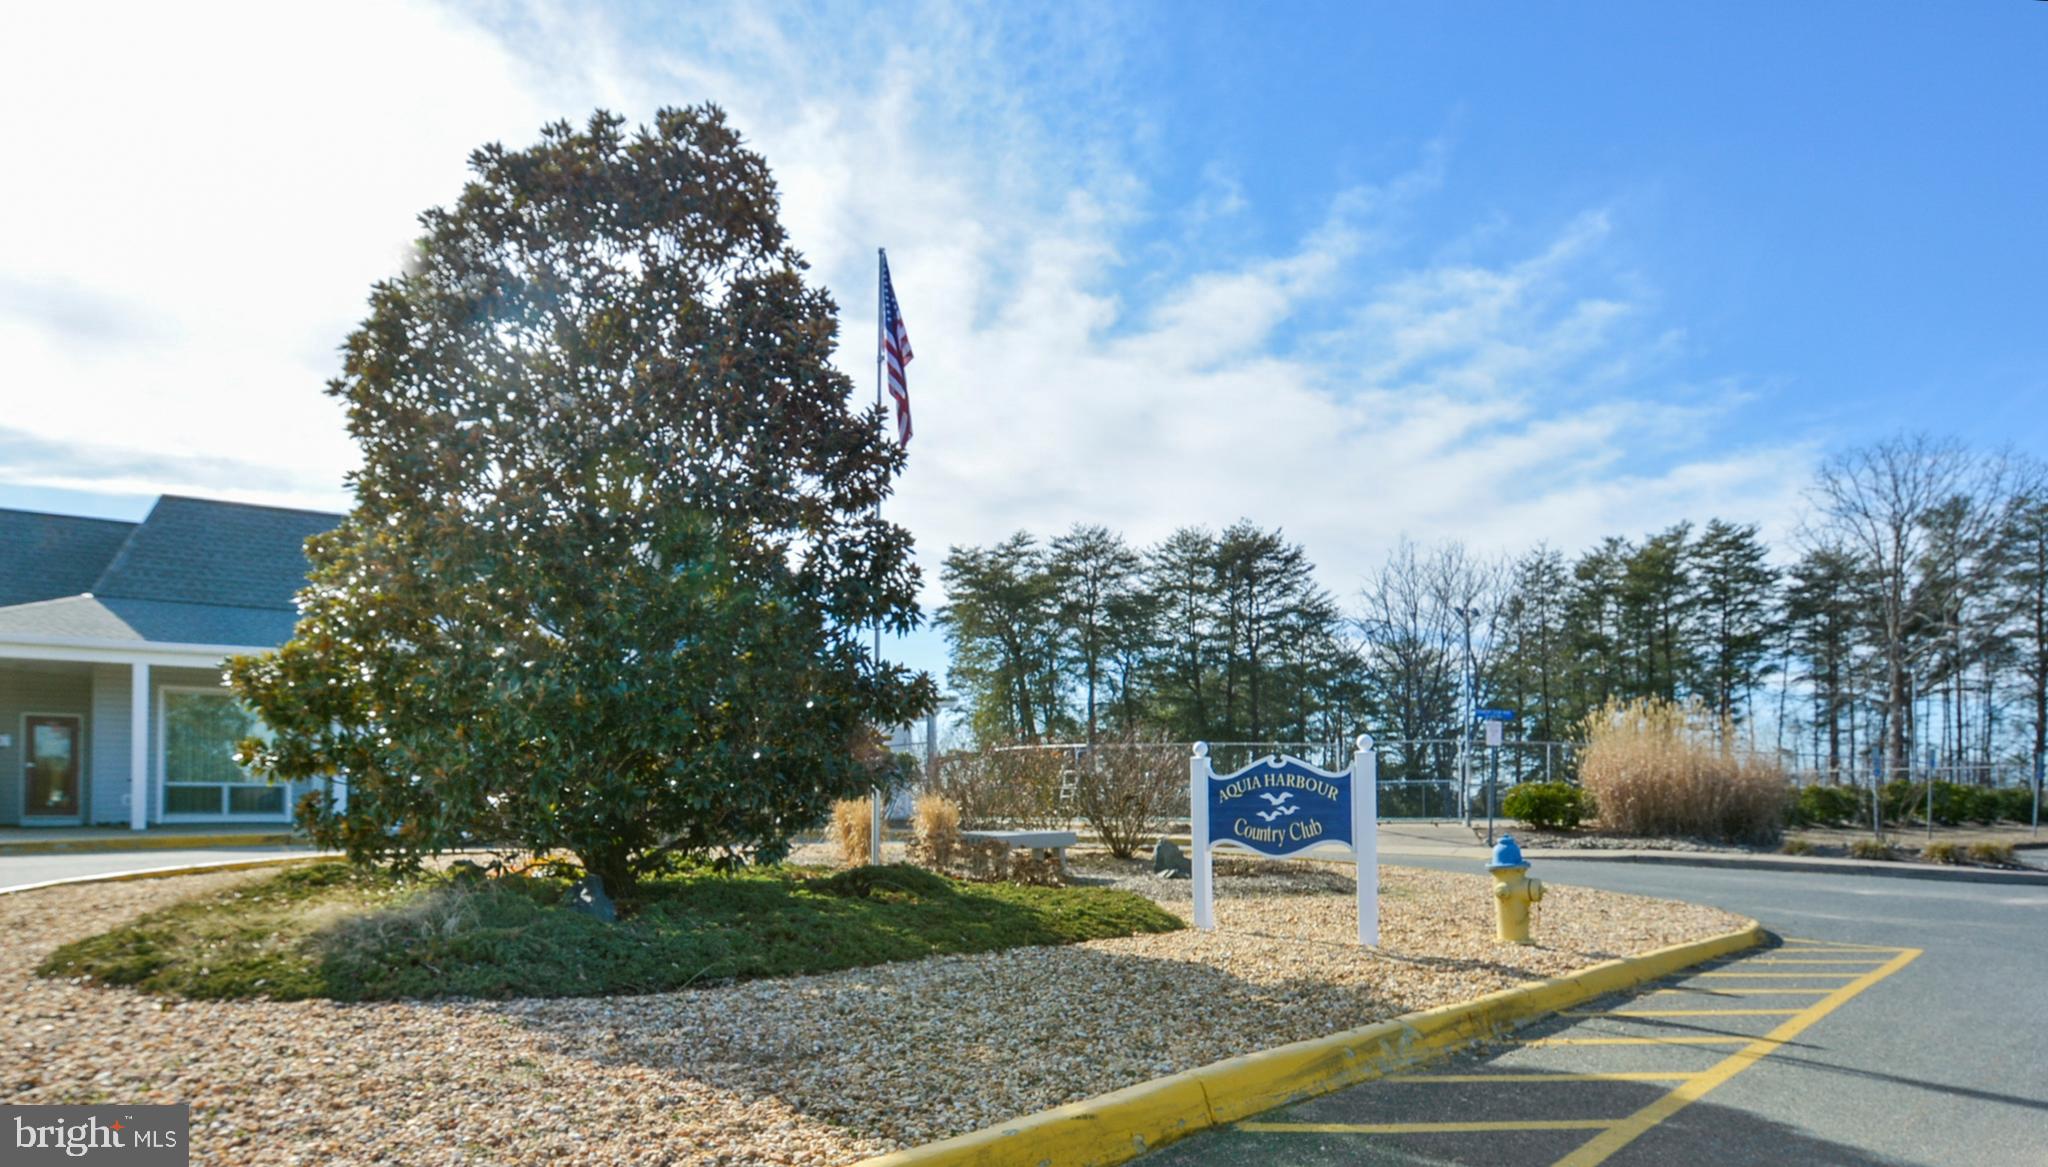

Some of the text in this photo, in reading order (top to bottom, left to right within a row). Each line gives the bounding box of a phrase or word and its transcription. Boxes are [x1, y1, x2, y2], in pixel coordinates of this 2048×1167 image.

[1219, 773, 1339, 803] AQUIA HARBOUR
[1234, 817, 1323, 848] Country Club
